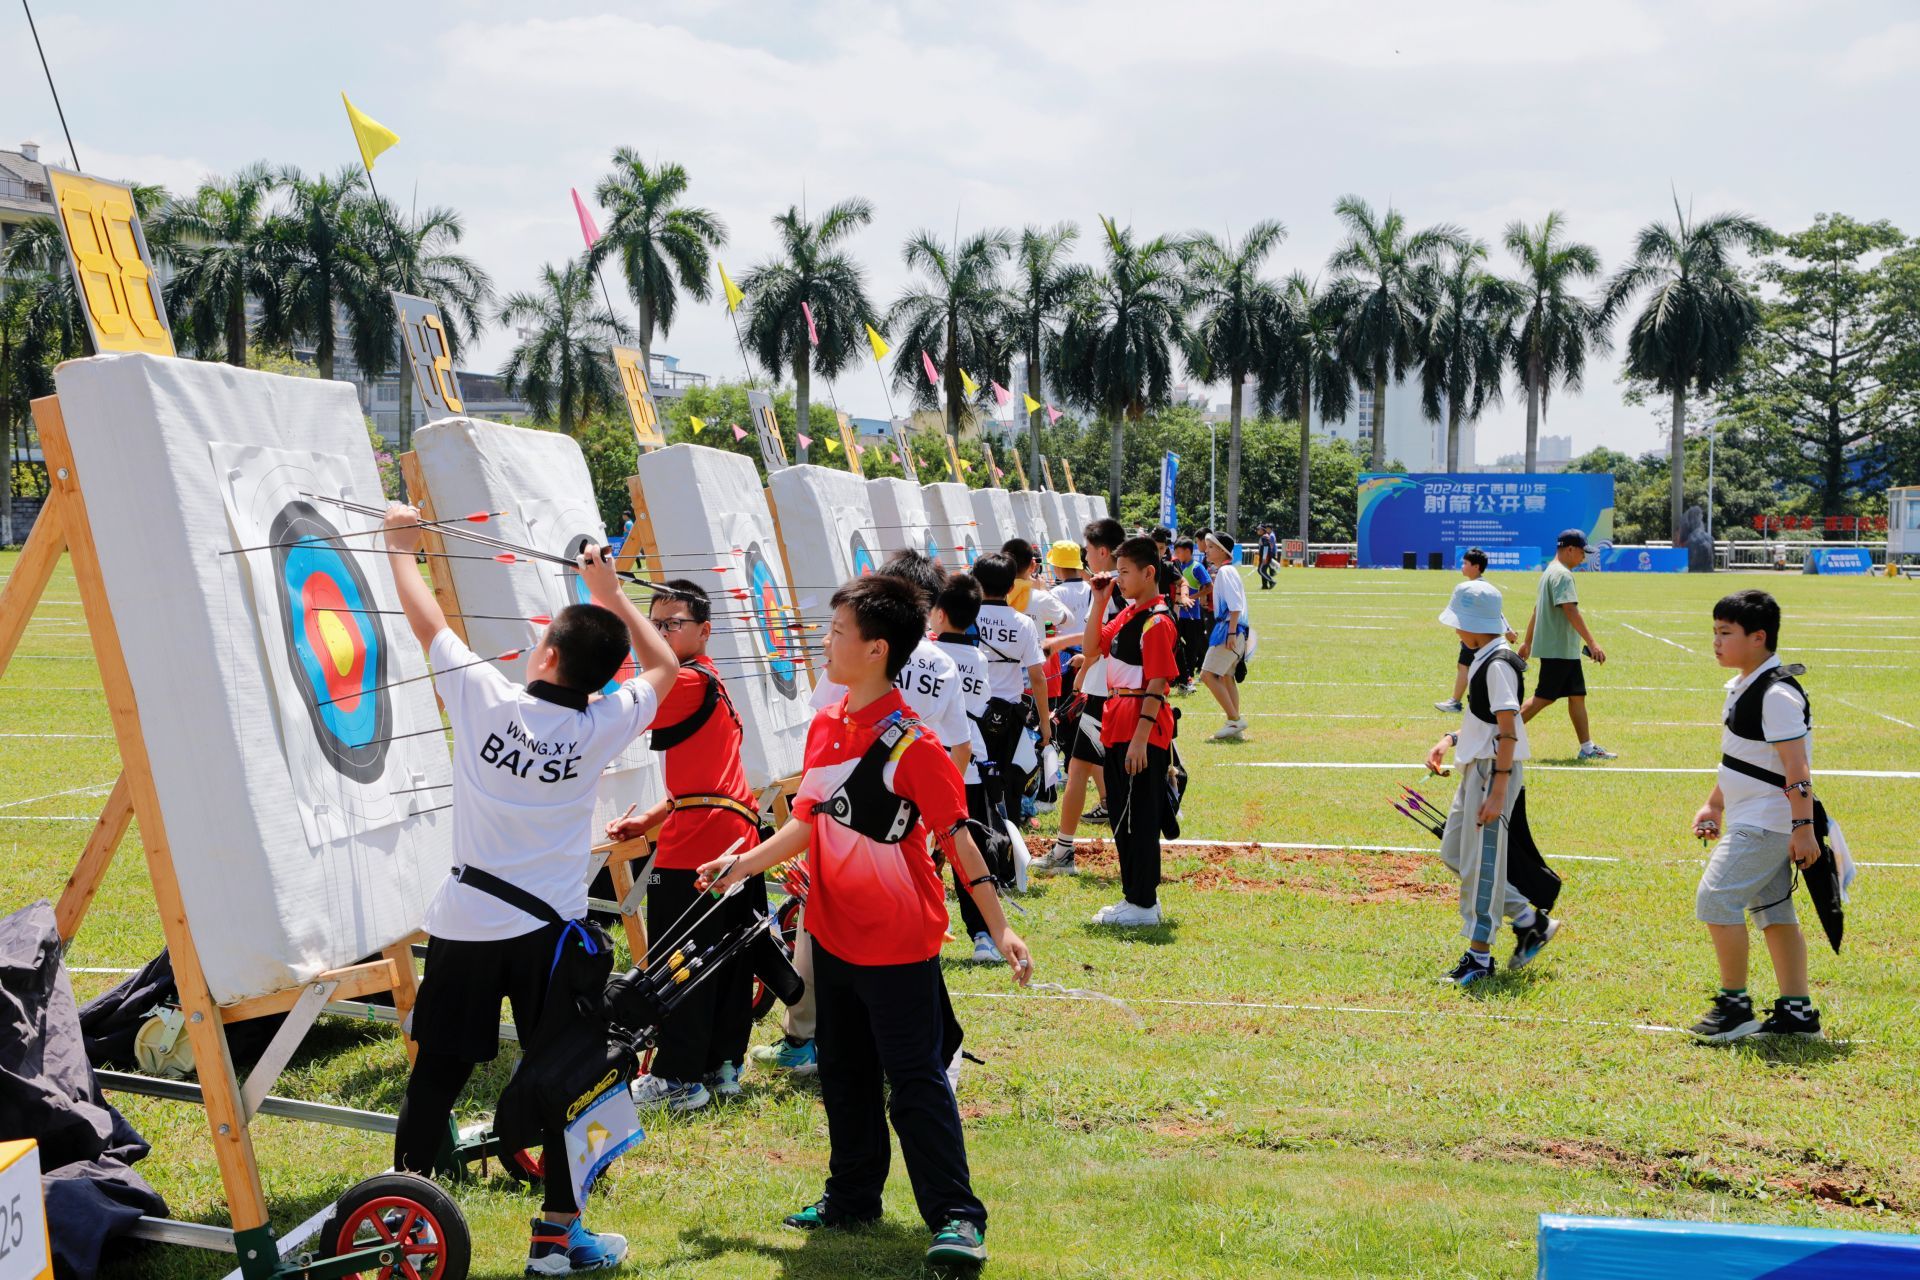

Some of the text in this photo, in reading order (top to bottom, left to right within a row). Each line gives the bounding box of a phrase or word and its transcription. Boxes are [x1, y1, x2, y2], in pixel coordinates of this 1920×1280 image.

[1424, 483, 1547, 495] 2024年广西青少年
[1424, 495, 1547, 514] 射箭公开赛
[980, 626, 1018, 643] AI SE
[892, 670, 945, 698] AI SE
[962, 676, 984, 696] SE
[479, 732, 582, 784] BAI SE
